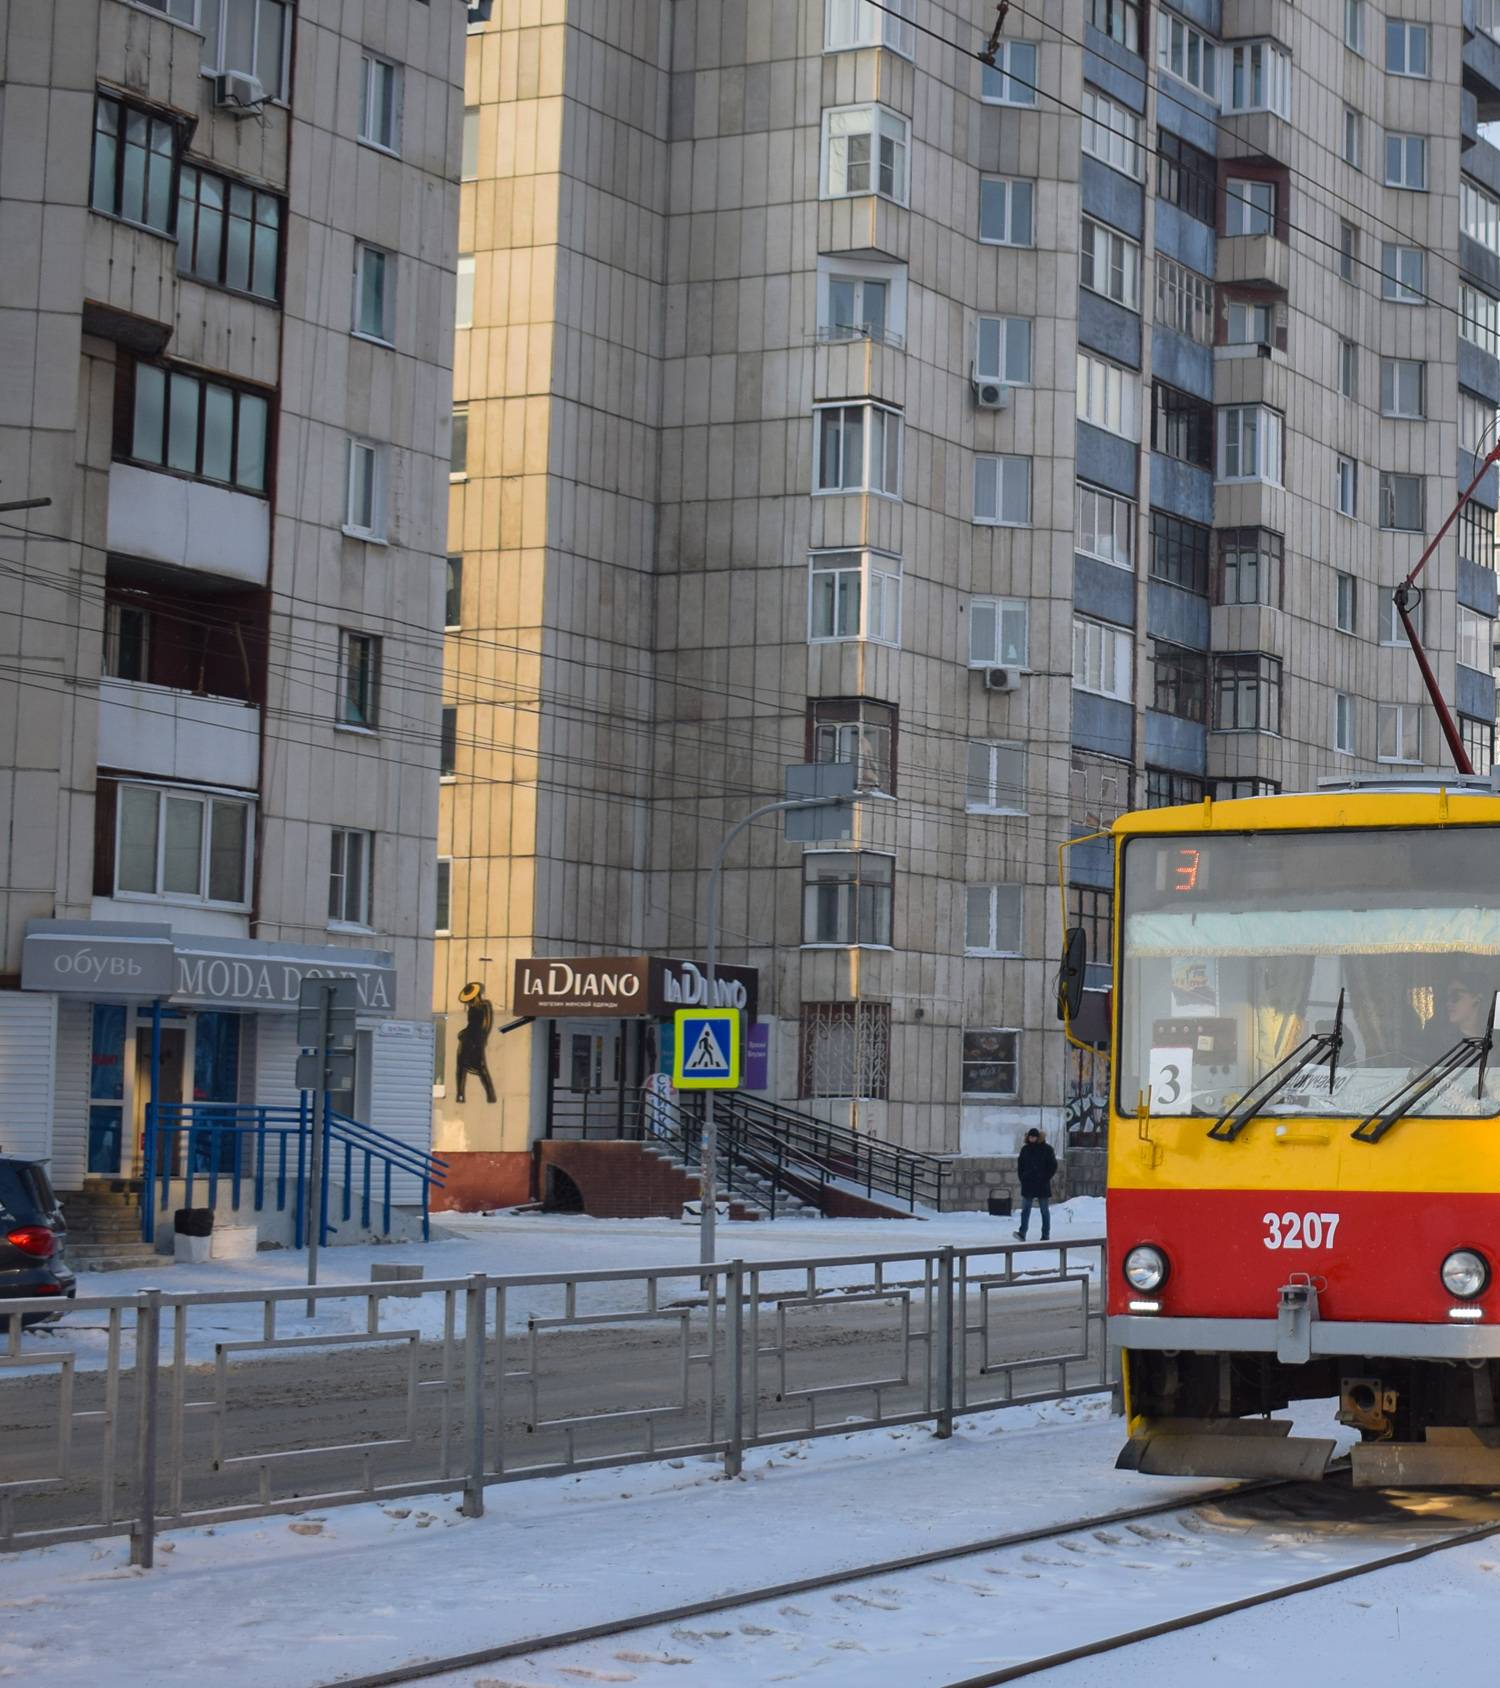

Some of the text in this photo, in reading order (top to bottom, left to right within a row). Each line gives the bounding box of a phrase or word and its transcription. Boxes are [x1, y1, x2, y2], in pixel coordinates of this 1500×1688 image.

[1175, 849, 1200, 890] 3
[54, 948, 143, 983] обувь
[177, 957, 391, 1008] MODA DNA
[1158, 1064, 1181, 1104] 3
[1263, 1211, 1340, 1250] 3207
